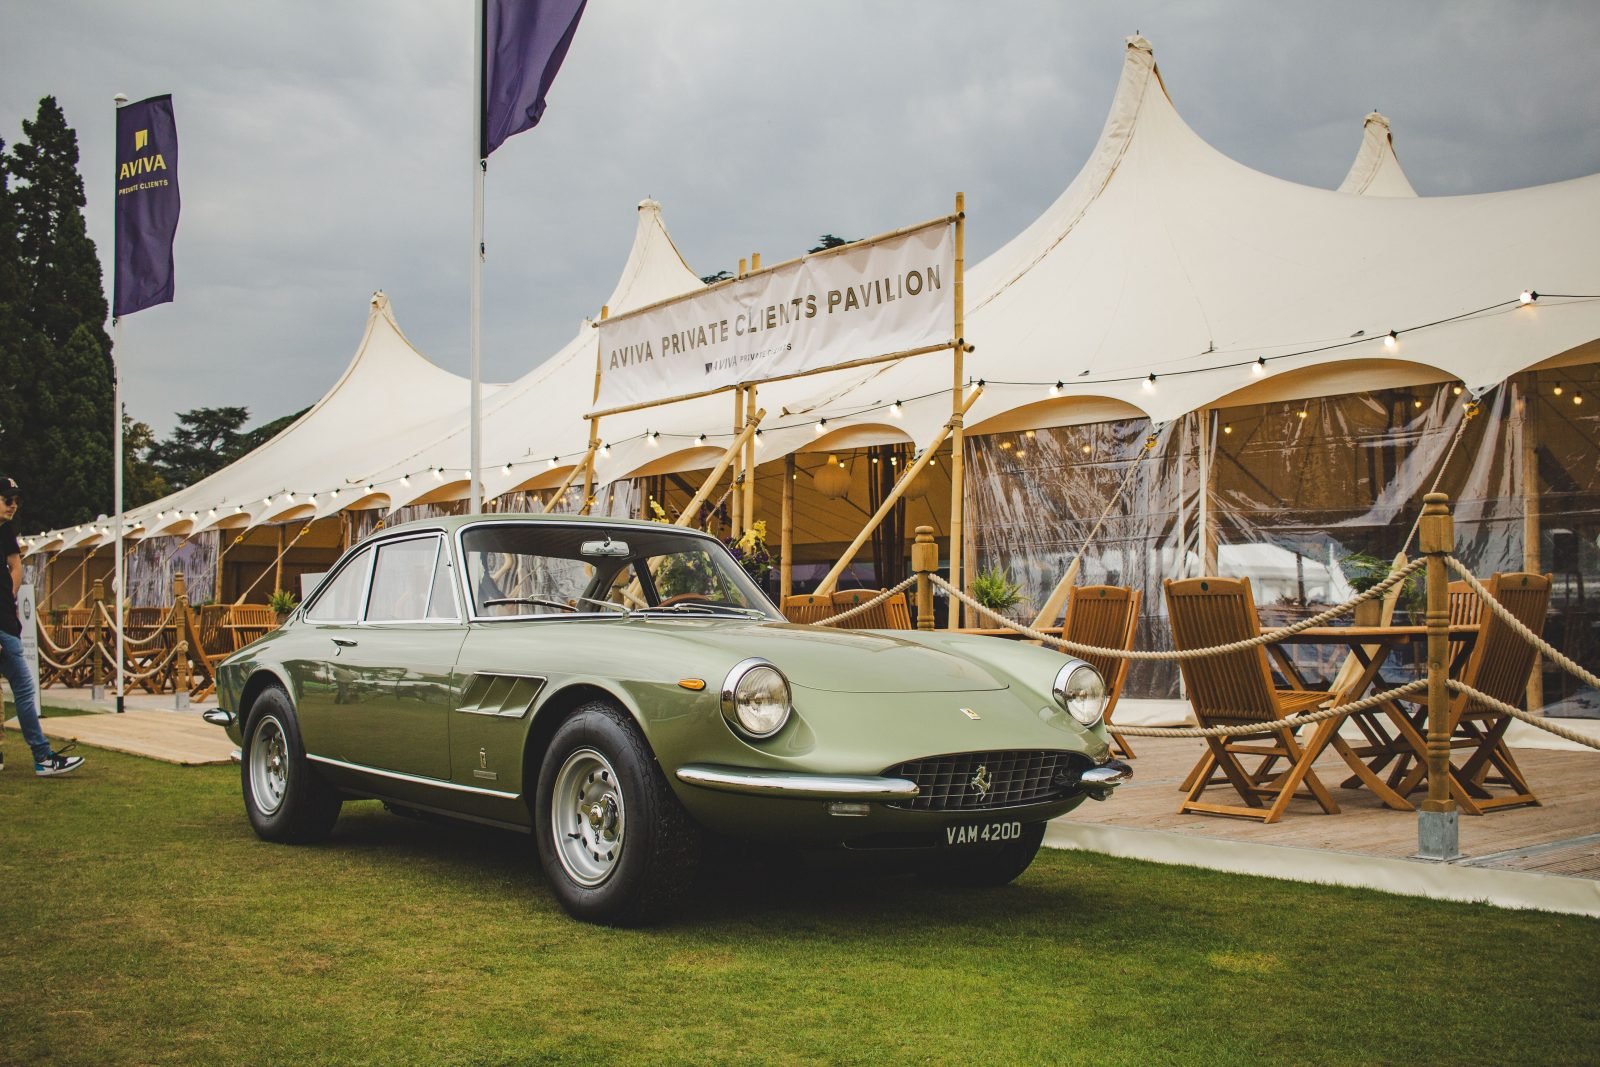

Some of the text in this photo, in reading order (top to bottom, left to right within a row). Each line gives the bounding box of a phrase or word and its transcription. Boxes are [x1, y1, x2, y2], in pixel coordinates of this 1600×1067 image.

[120, 154, 166, 180] AVIVA
[119, 180, 168, 195] PRIVATE CLIENTS
[609, 264, 941, 370] AVIVA PRIVATE CLIENTS PAVILION
